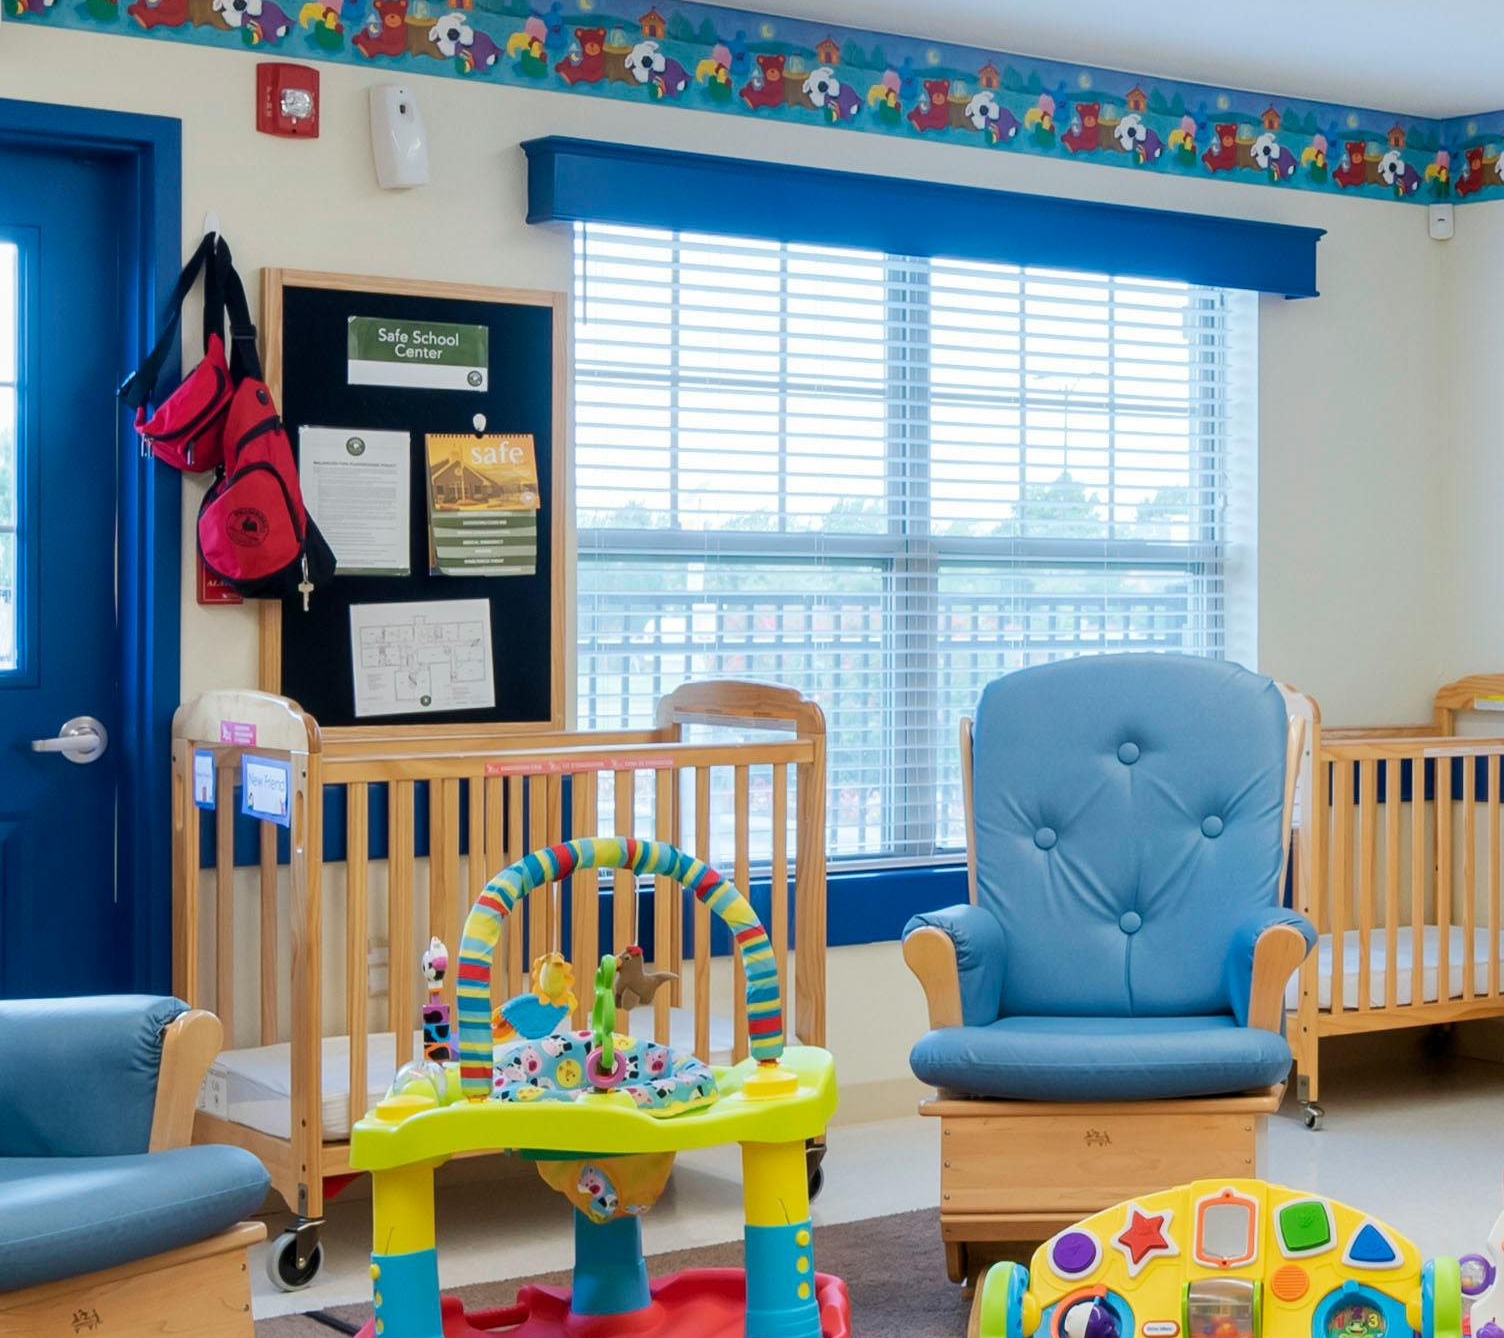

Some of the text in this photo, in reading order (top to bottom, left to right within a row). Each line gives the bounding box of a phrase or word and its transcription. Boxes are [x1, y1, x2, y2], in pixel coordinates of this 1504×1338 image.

[378, 327, 460, 347] Safe School
[394, 343, 444, 360] Center
[470, 440, 524, 465] safe
